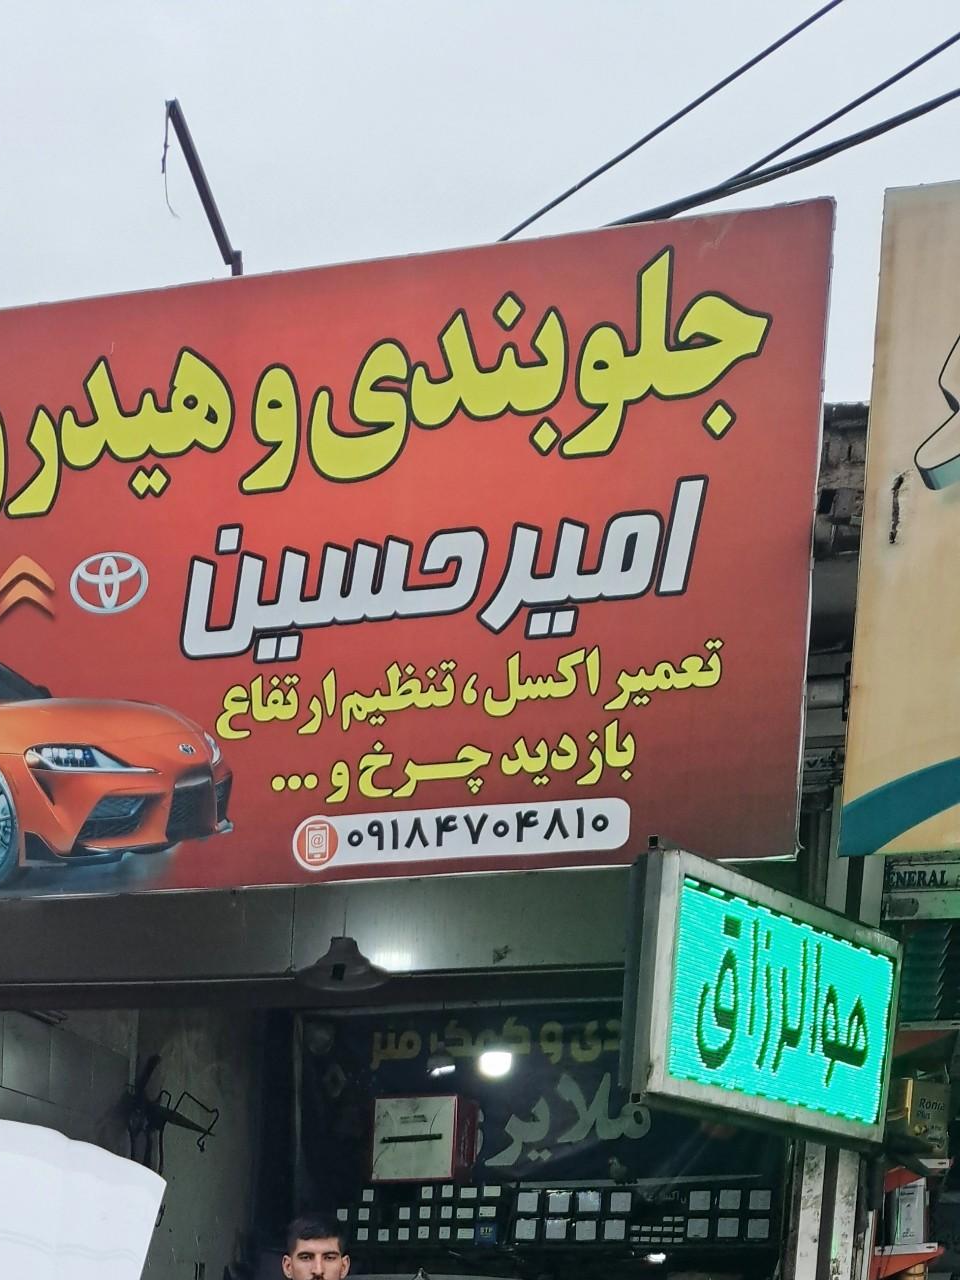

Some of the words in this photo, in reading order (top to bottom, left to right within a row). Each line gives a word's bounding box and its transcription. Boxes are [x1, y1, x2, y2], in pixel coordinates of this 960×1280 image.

[307, 246, 771, 482] جلوبندی
[238, 363, 302, 495] و
[179, 475, 708, 663] امیرحسین
[215, 668, 337, 740] ارتفاع
[340, 659, 456, 731] تنظیم
[603, 637, 723, 711] تعمیر
[357, 738, 492, 800] چرخ
[499, 719, 636, 787] بازدید
[346, 806, 610, 852] ۰۹۱۸۴۷۰۴۸۱۰
[888, 868, 949, 889] ENERAL
[476, 1071, 652, 1167] ملایر
